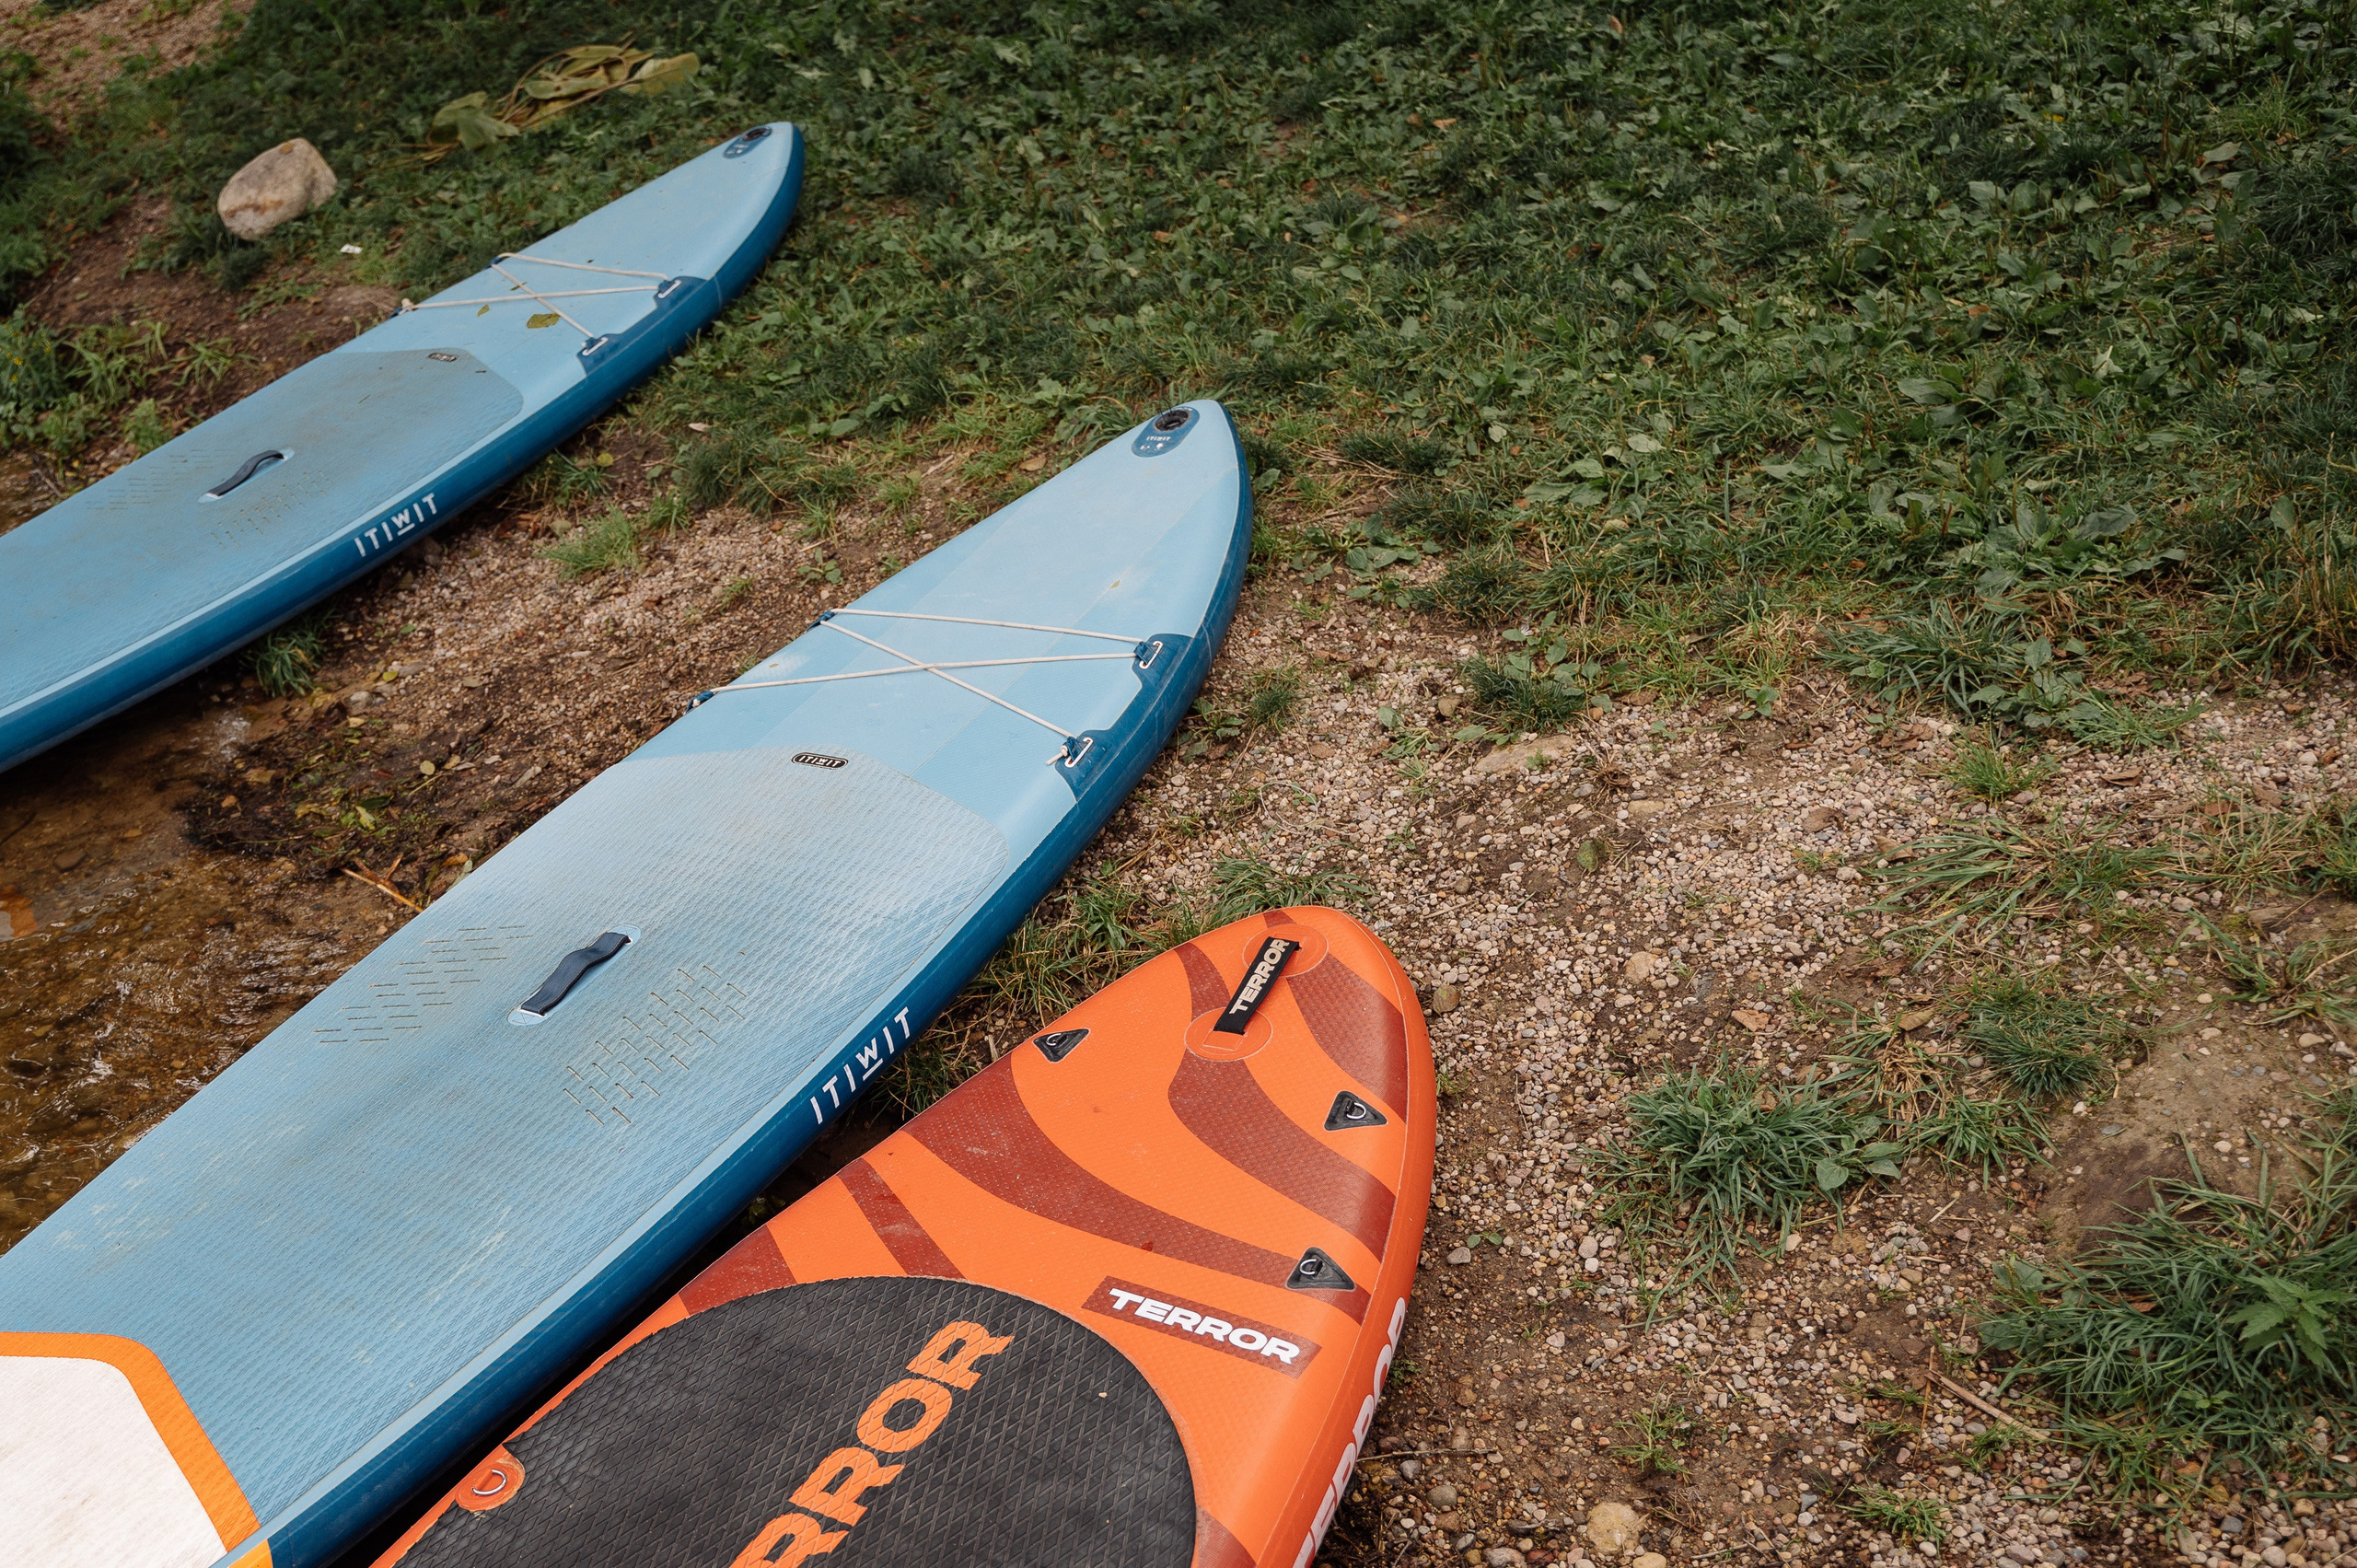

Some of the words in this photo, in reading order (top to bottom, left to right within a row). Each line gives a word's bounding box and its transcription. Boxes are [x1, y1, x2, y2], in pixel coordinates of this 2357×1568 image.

[354, 493, 437, 557] ITIWIT
[798, 755, 842, 767] ITIWIT
[1229, 938, 1290, 1015] TERROR
[809, 1006, 910, 1125] ITIWIT
[1109, 1287, 1301, 1365] TERROR
